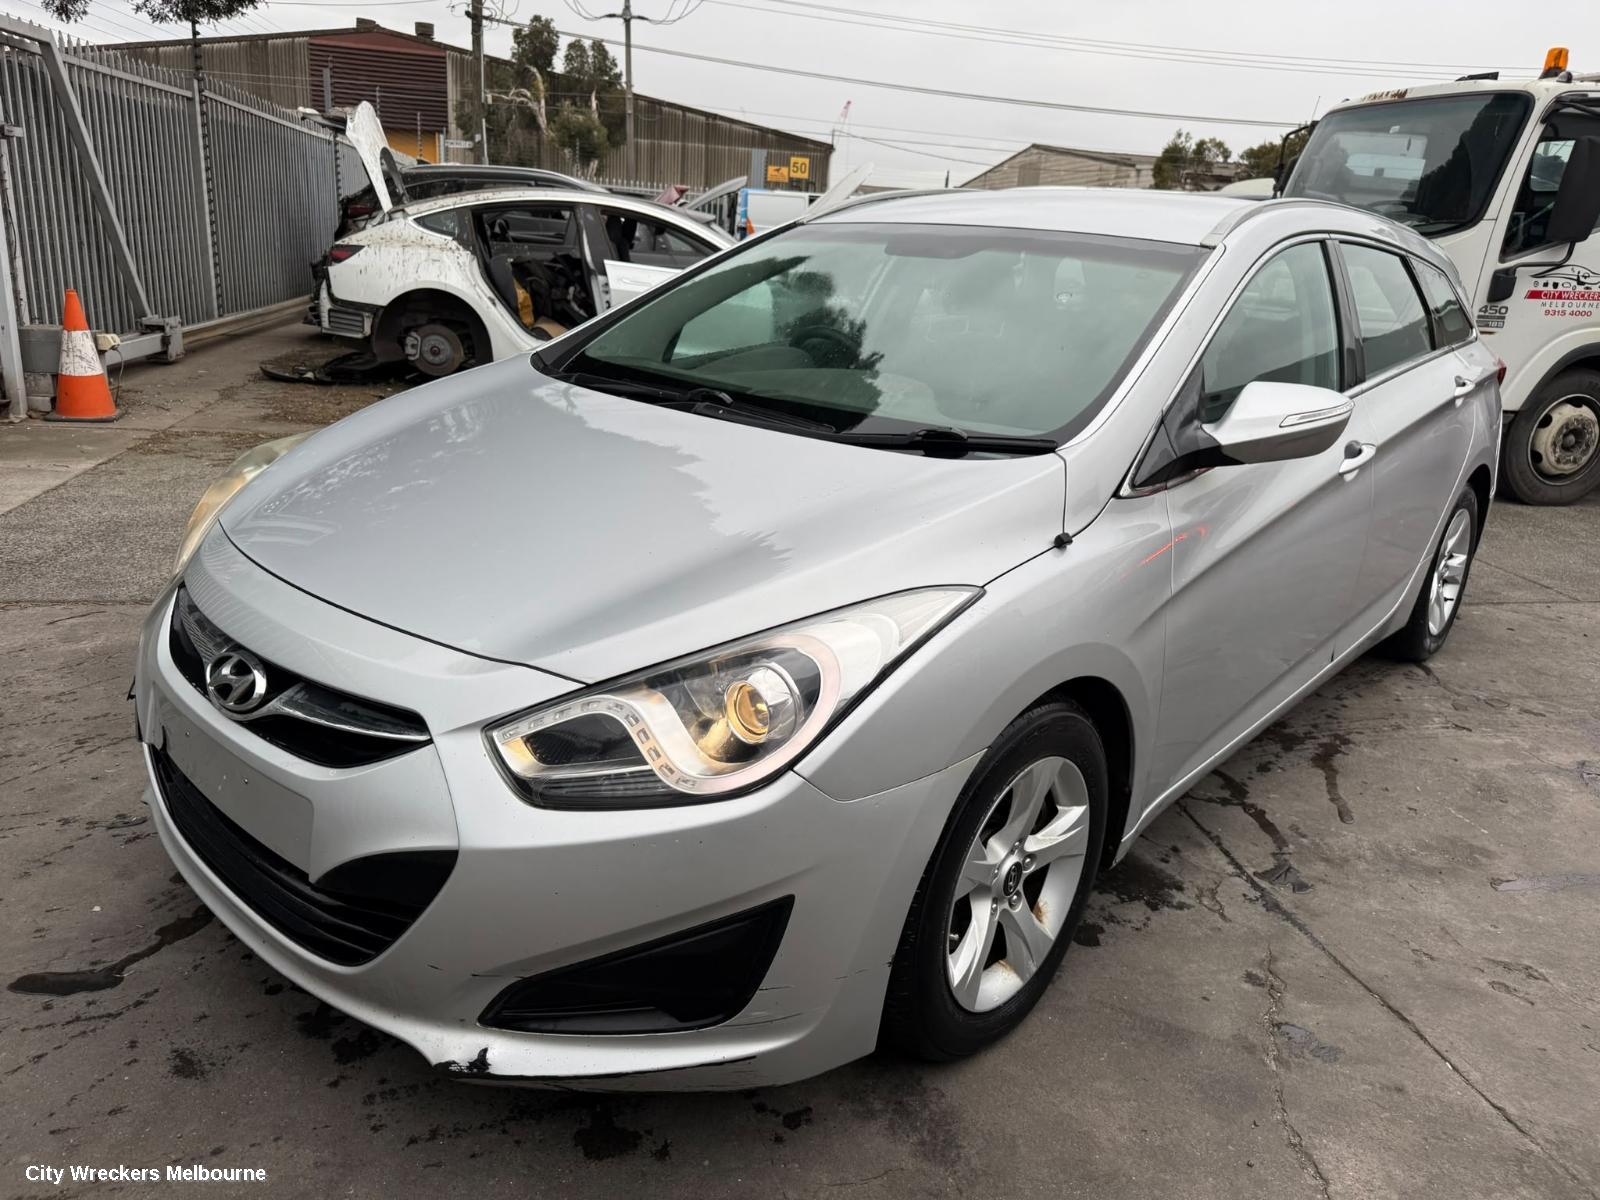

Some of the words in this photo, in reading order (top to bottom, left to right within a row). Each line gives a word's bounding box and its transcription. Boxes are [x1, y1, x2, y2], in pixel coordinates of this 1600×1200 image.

[791, 161, 807, 174] 50
[1541, 291, 1560, 299] CITY
[1541, 301, 1600, 309] MELBOURNE
[1479, 304, 1509, 315] 450
[1544, 309, 1567, 317] 9315
